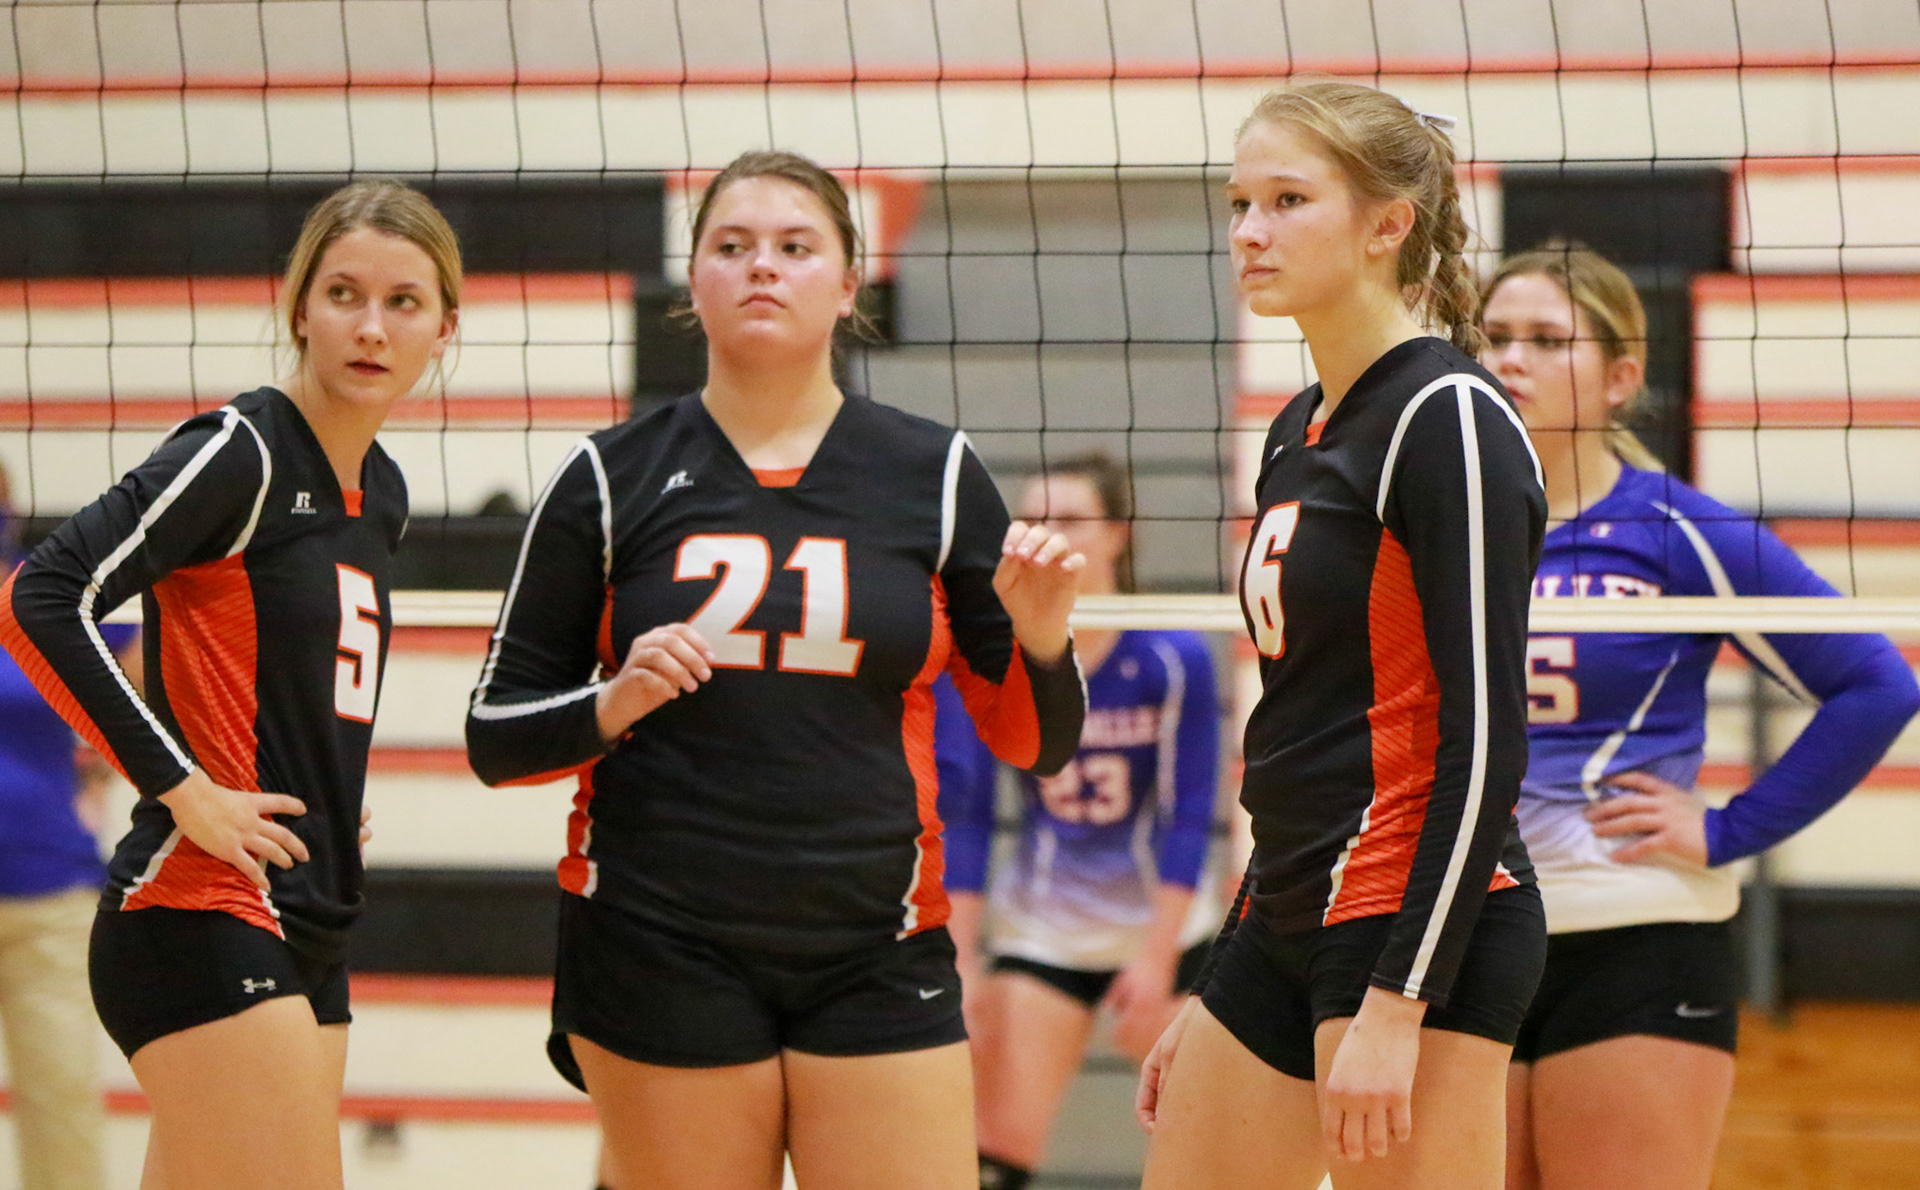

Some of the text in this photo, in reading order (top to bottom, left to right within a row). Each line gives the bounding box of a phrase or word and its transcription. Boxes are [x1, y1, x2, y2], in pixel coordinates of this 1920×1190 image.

[295, 491, 311, 508] R
[334, 562, 381, 724] 5
[672, 532, 866, 678] 21
[1245, 500, 1301, 660] 6
[1526, 635, 1580, 725] 5
